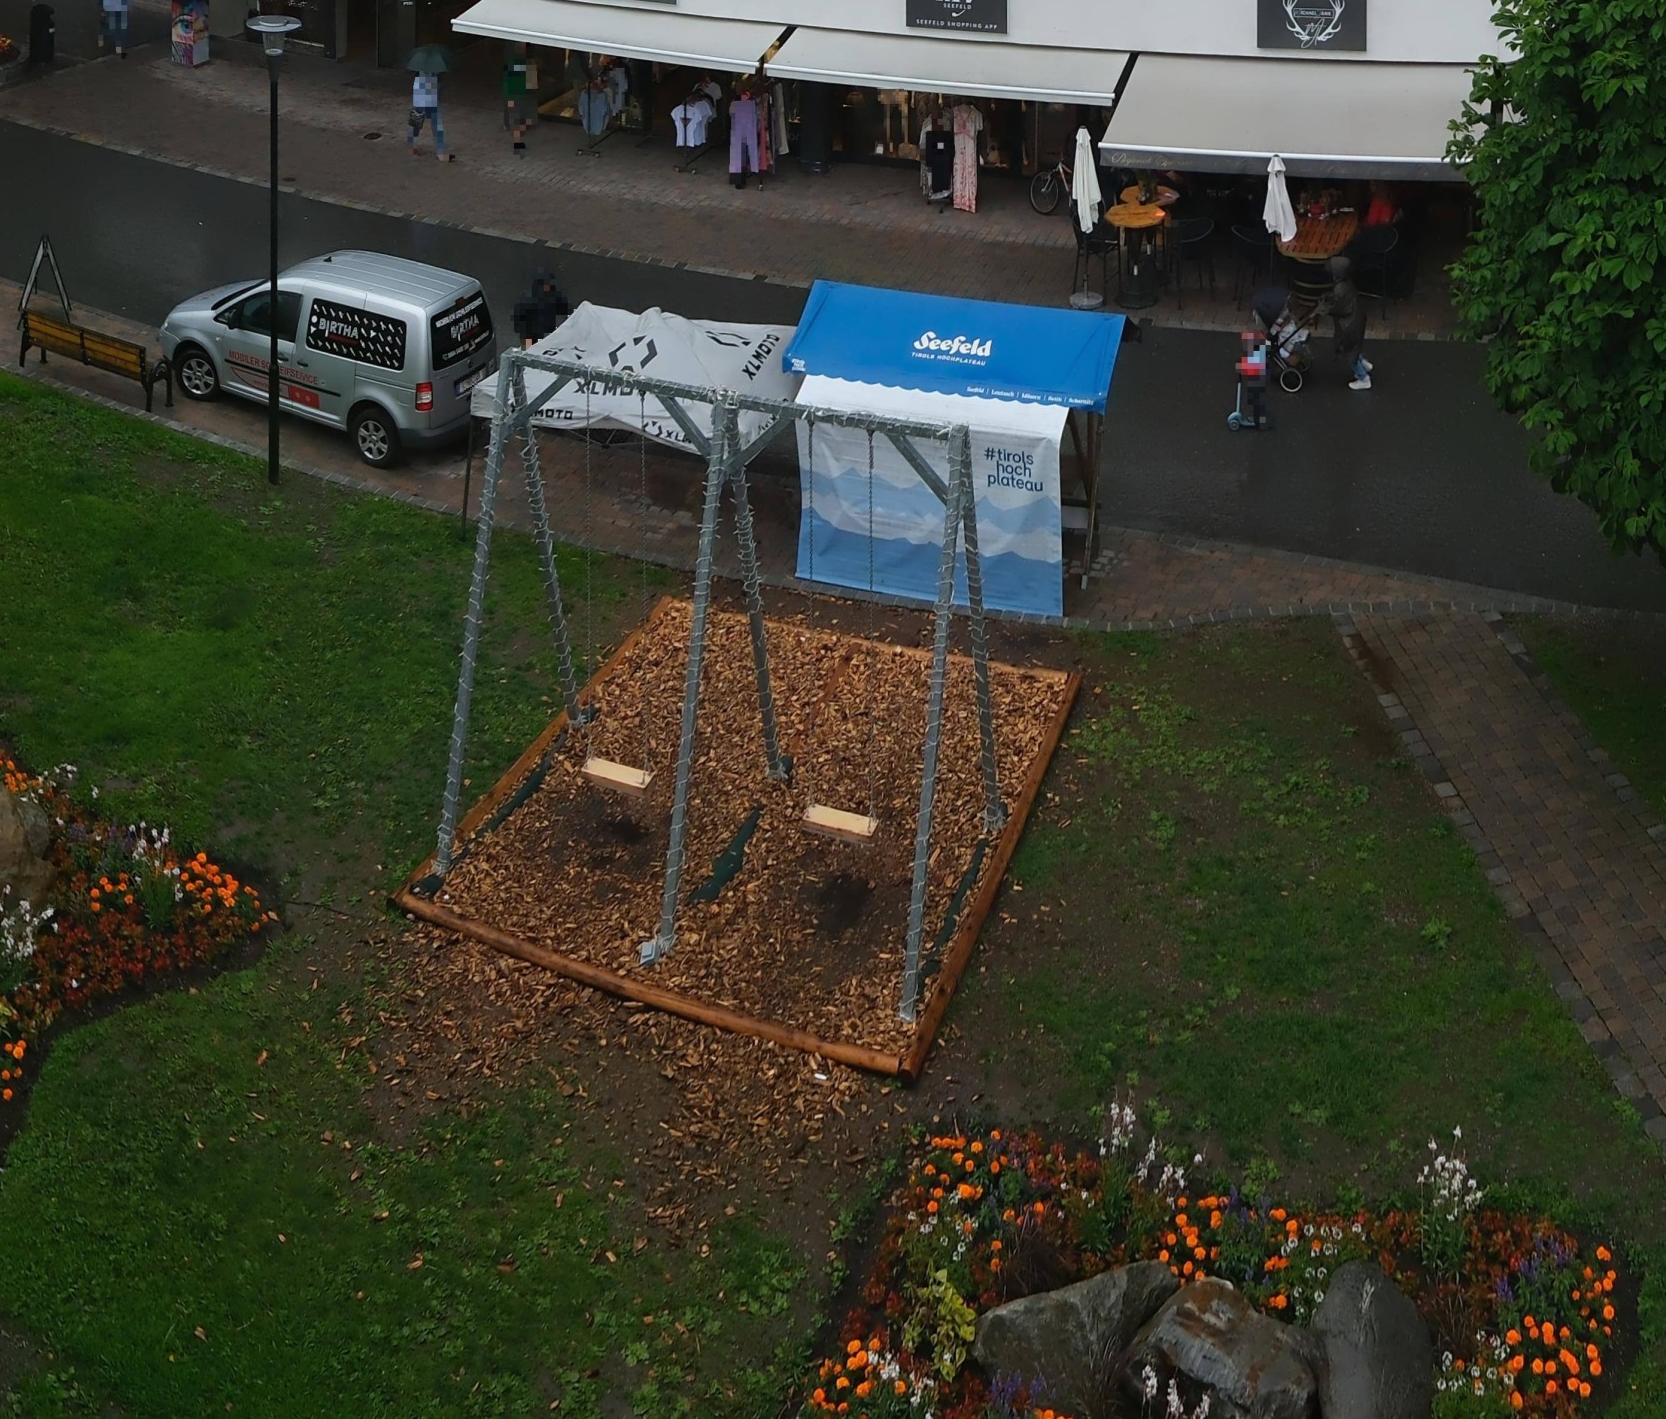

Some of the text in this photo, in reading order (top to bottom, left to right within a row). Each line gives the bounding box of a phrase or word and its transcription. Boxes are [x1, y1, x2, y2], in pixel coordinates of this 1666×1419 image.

[916, 19, 945, 27] SEEFELD
[947, 20, 983, 29] SHOPPING
[318, 317, 361, 339] BIRTHA
[913, 331, 992, 358] Seefeld
[229, 350, 260, 366] MOBILER
[741, 334, 780, 381] XLMOTO
[984, 447, 1034, 465] #tirols
[996, 461, 1032, 480] hoch
[987, 473, 1044, 493] plateau
